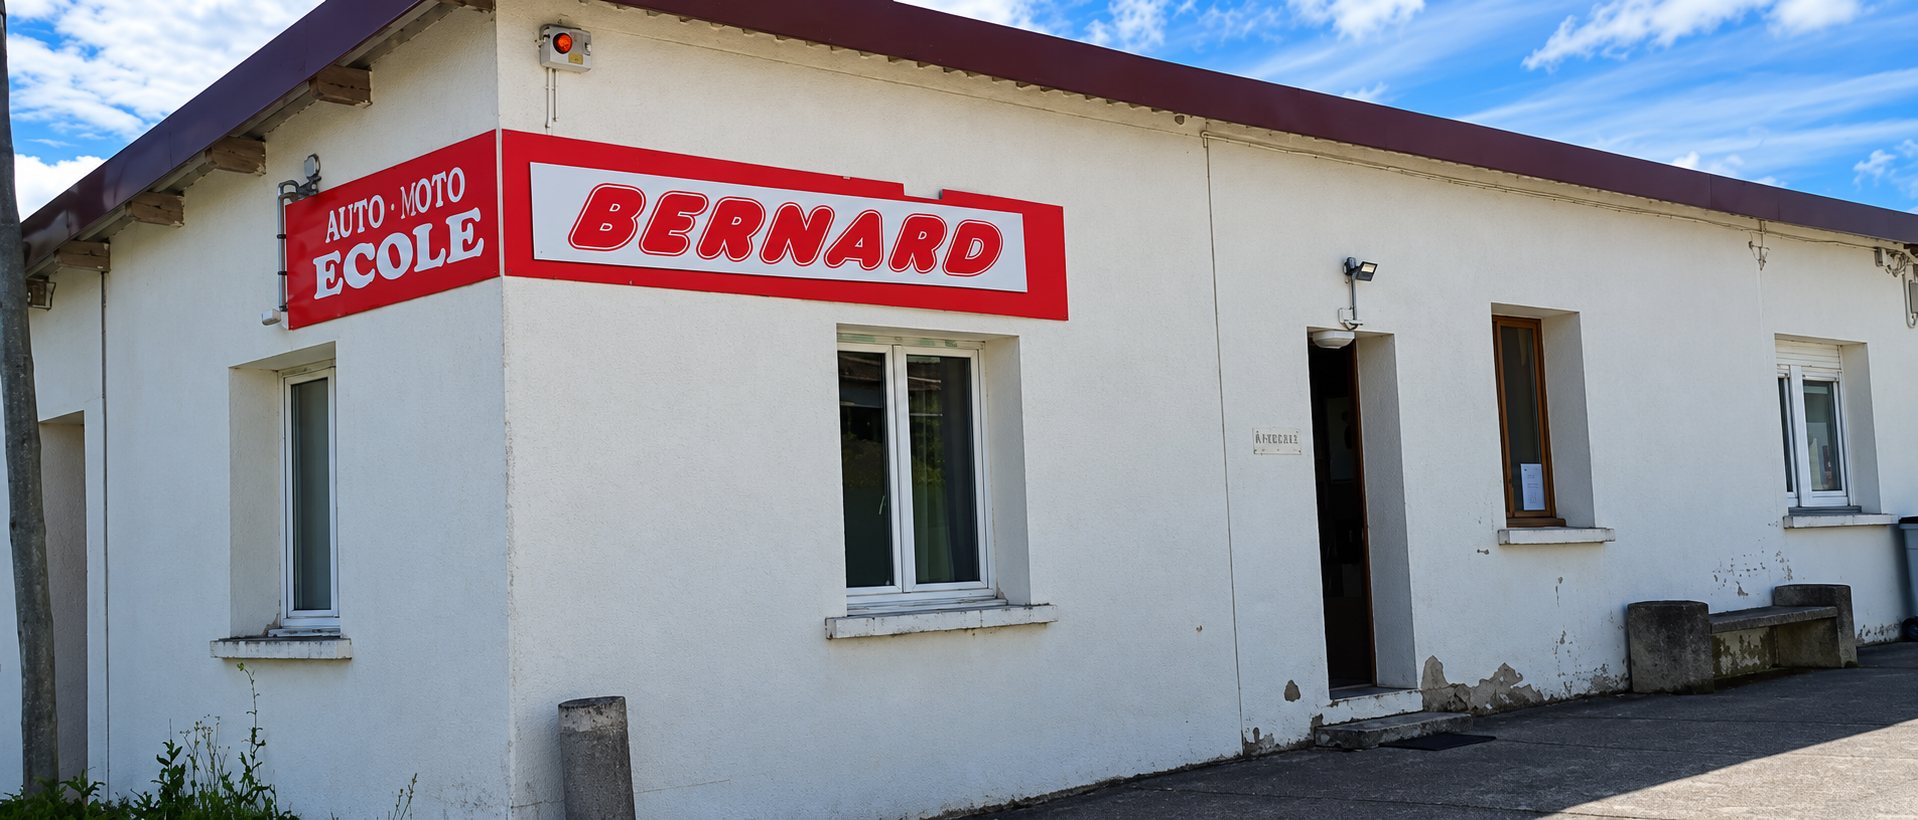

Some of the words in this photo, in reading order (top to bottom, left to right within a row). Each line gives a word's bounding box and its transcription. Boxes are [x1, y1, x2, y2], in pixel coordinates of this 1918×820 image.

[325, 194, 385, 243] AUTO
[400, 166, 465, 220] MOTO
[568, 182, 1003, 277] BERNARD
[313, 207, 484, 299] ECOLE
